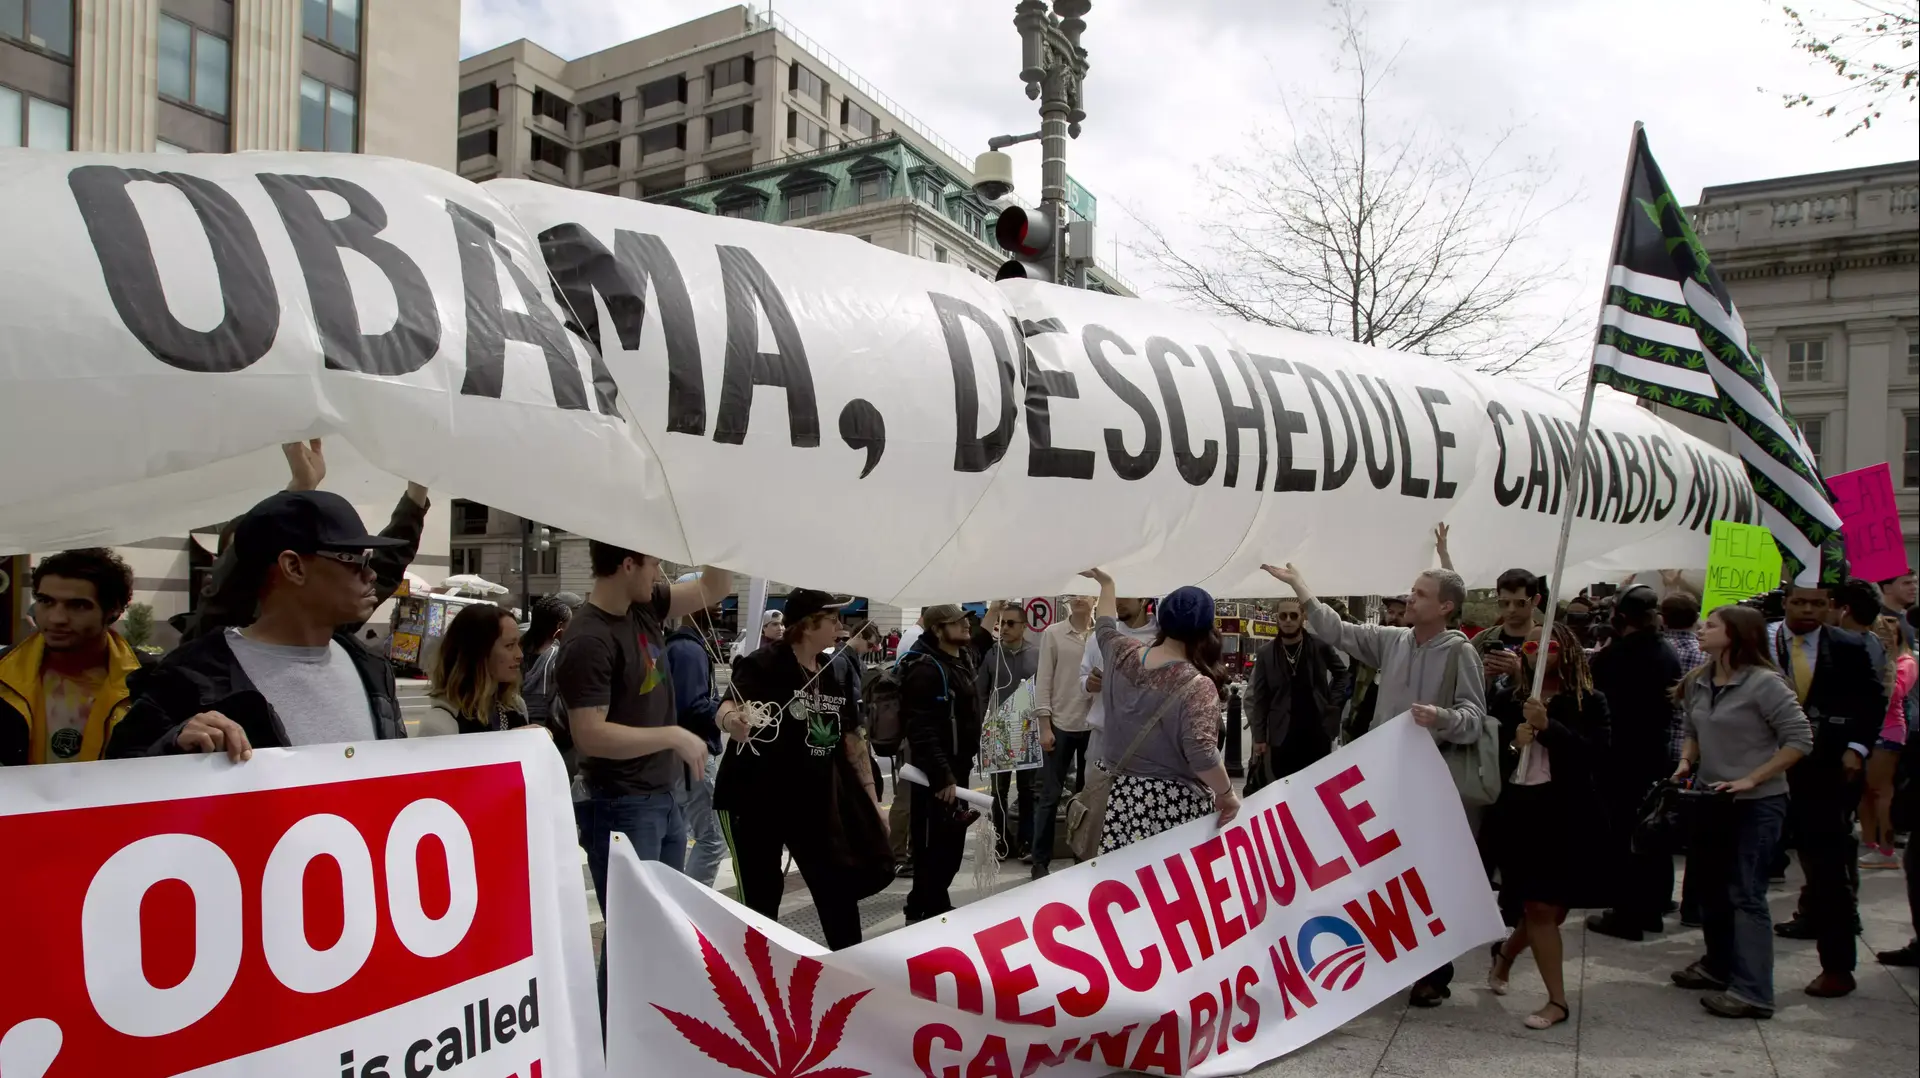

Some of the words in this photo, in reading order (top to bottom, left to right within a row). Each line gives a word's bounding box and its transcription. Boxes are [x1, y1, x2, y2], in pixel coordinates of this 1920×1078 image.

[67, 164, 887, 480] OBAMA,
[928, 290, 1459, 500] DESCHEDULE
[1486, 399, 1678, 525] CANNABIS
[1713, 525, 1776, 563] HELP
[906, 764, 1401, 1029] DESCHEDULE
[1268, 866, 1447, 1021] NOW!
[404, 977, 541, 1076] called
